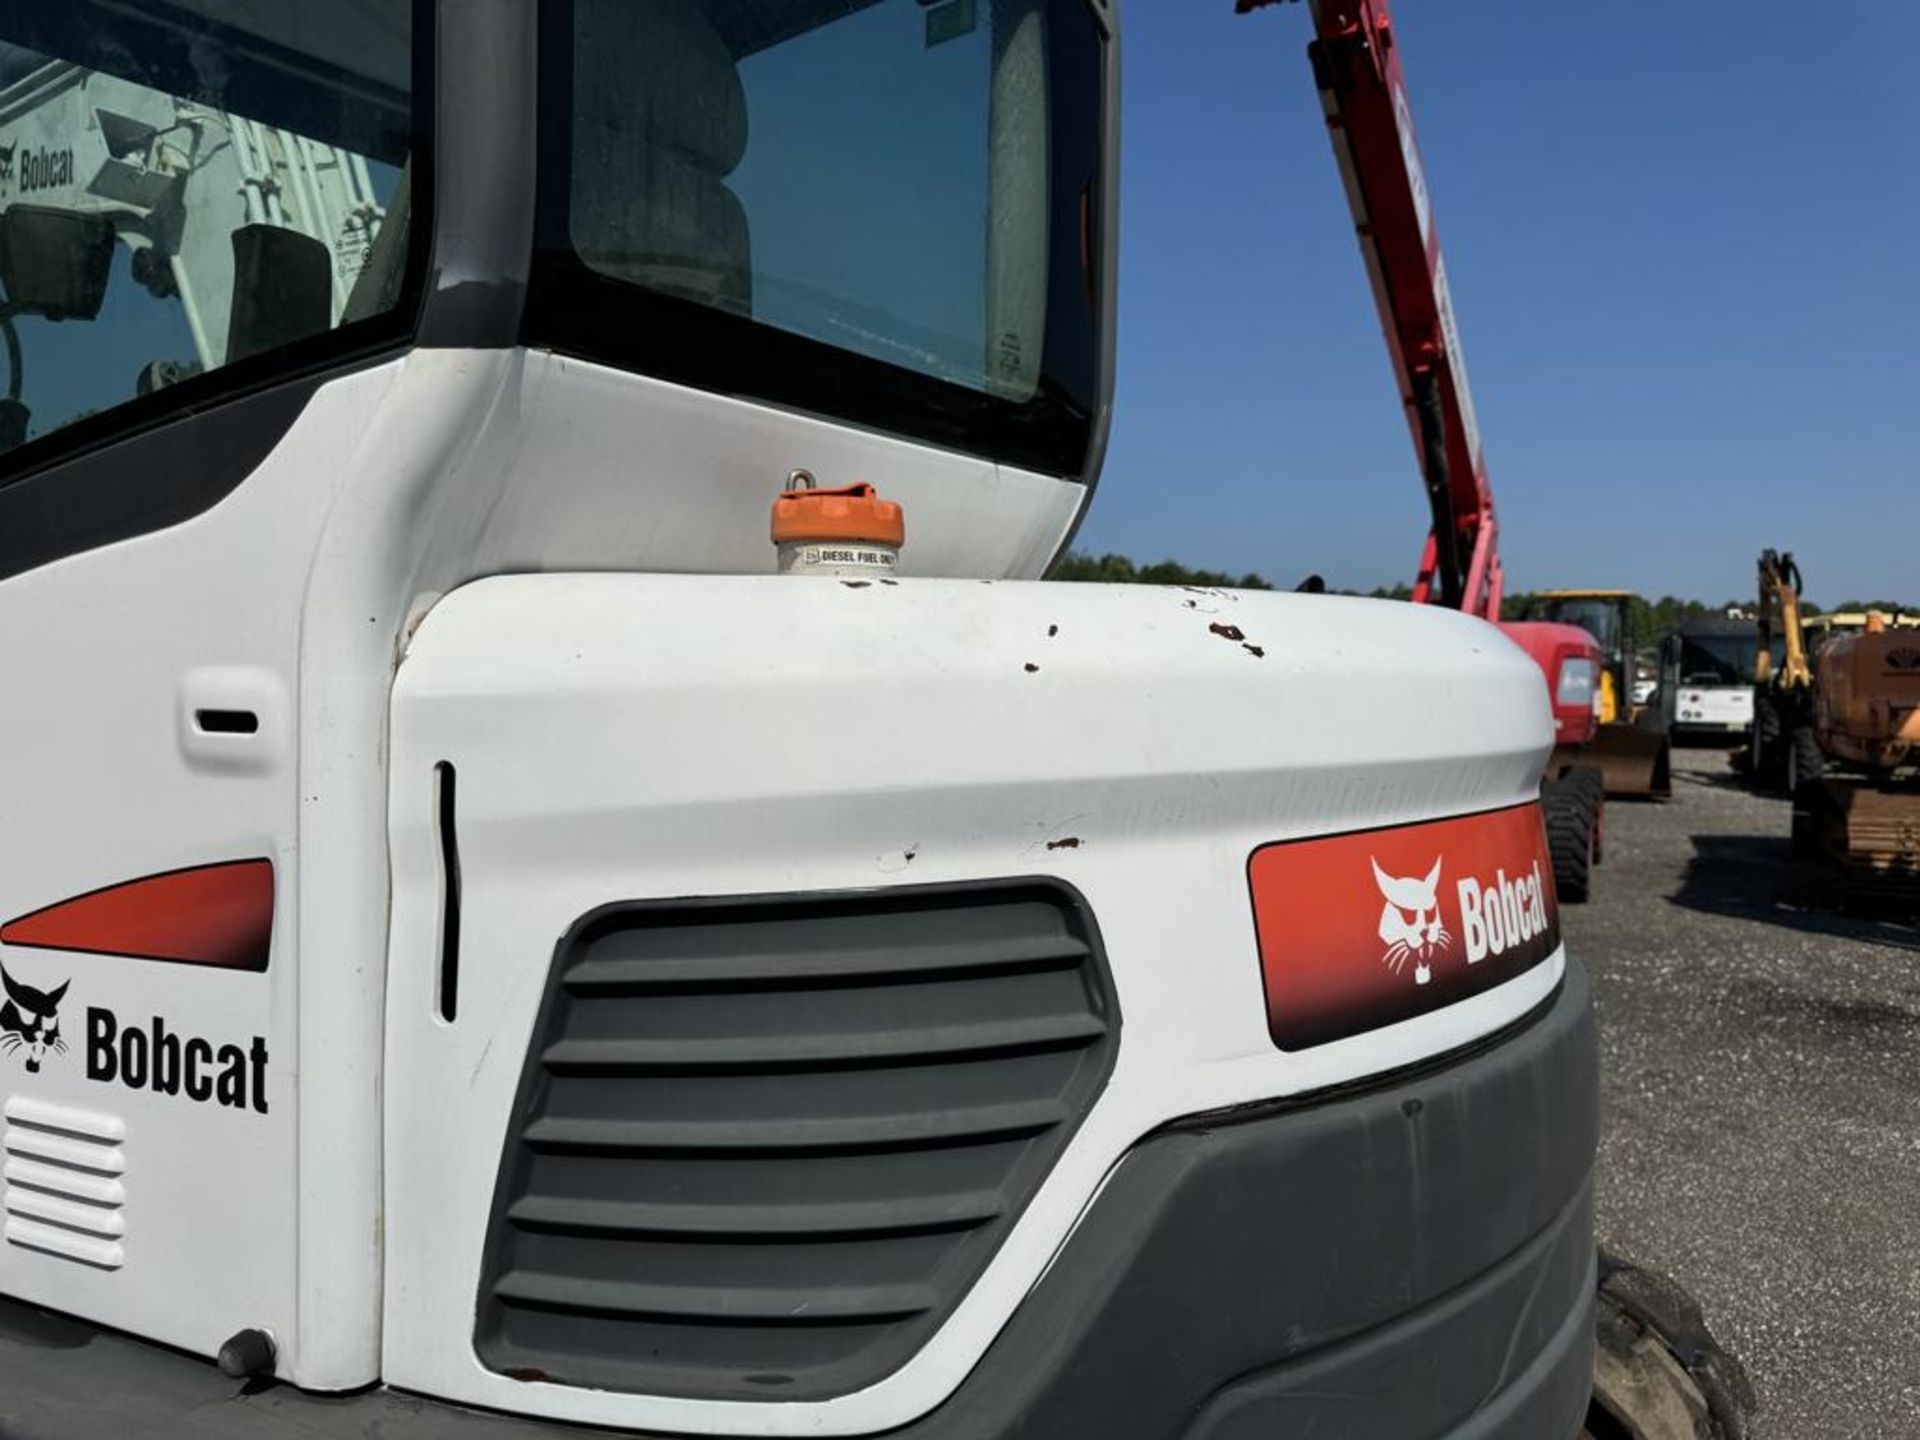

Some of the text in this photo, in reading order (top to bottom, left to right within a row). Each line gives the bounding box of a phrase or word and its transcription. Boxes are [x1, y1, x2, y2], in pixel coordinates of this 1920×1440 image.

[20, 145, 74, 191] Bobcat
[822, 550, 855, 562] DIESEL
[858, 551, 878, 563] FUEL
[1457, 860, 1547, 964] Bobcat
[87, 1007, 268, 1114] Bobcat
